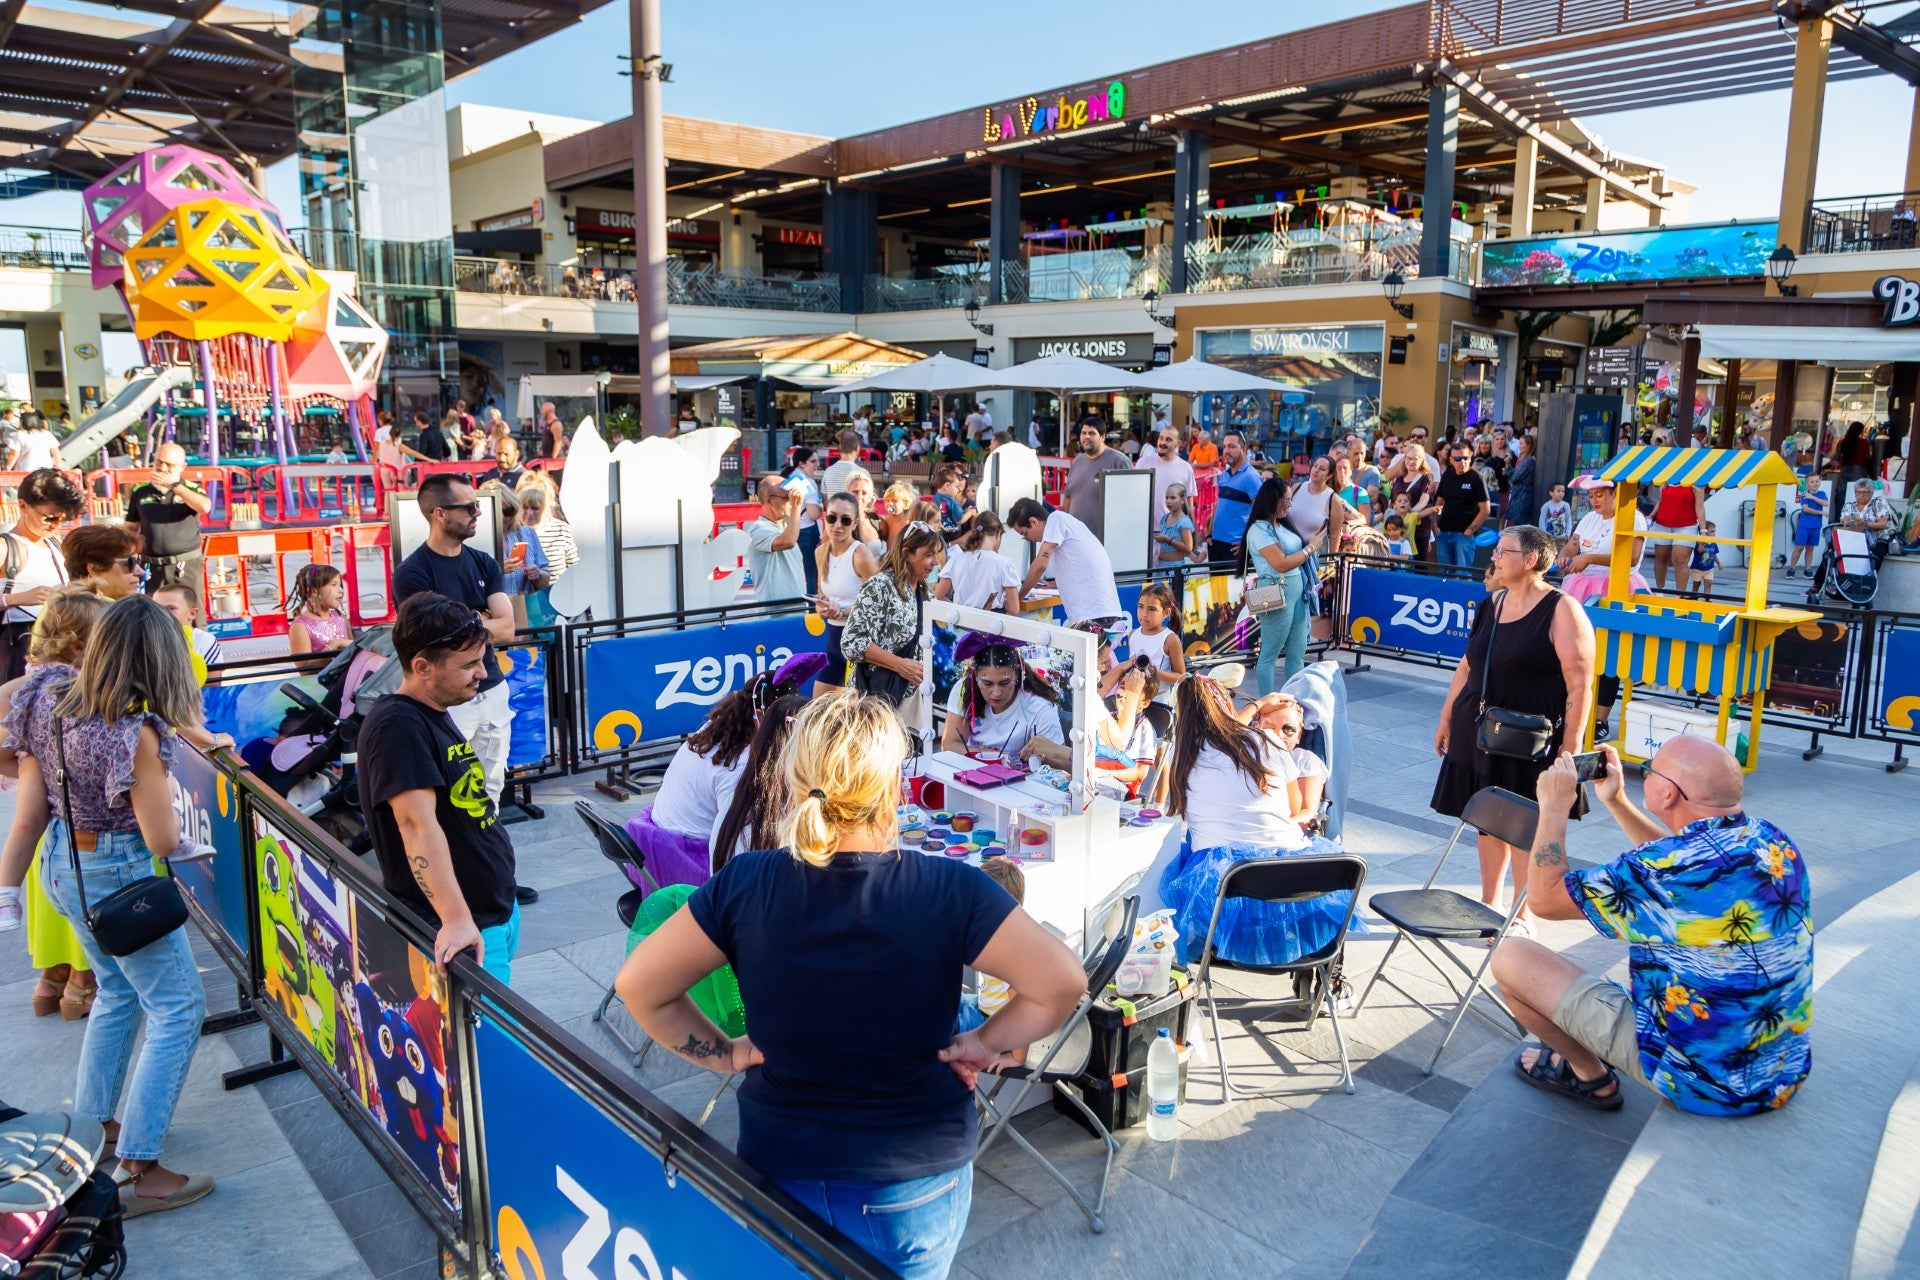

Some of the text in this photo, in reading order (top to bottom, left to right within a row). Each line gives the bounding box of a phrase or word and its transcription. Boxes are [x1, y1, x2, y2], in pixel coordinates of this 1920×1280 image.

[780, 228, 823, 246] LIZA
[1880, 276, 1920, 322] B
[1253, 331, 1350, 351] SWAROVSKI
[1391, 594, 1476, 635] zeni
[1446, 629, 1470, 639] BOUL
[1644, 737, 1663, 749] Pol
[167, 771, 214, 865] enia
